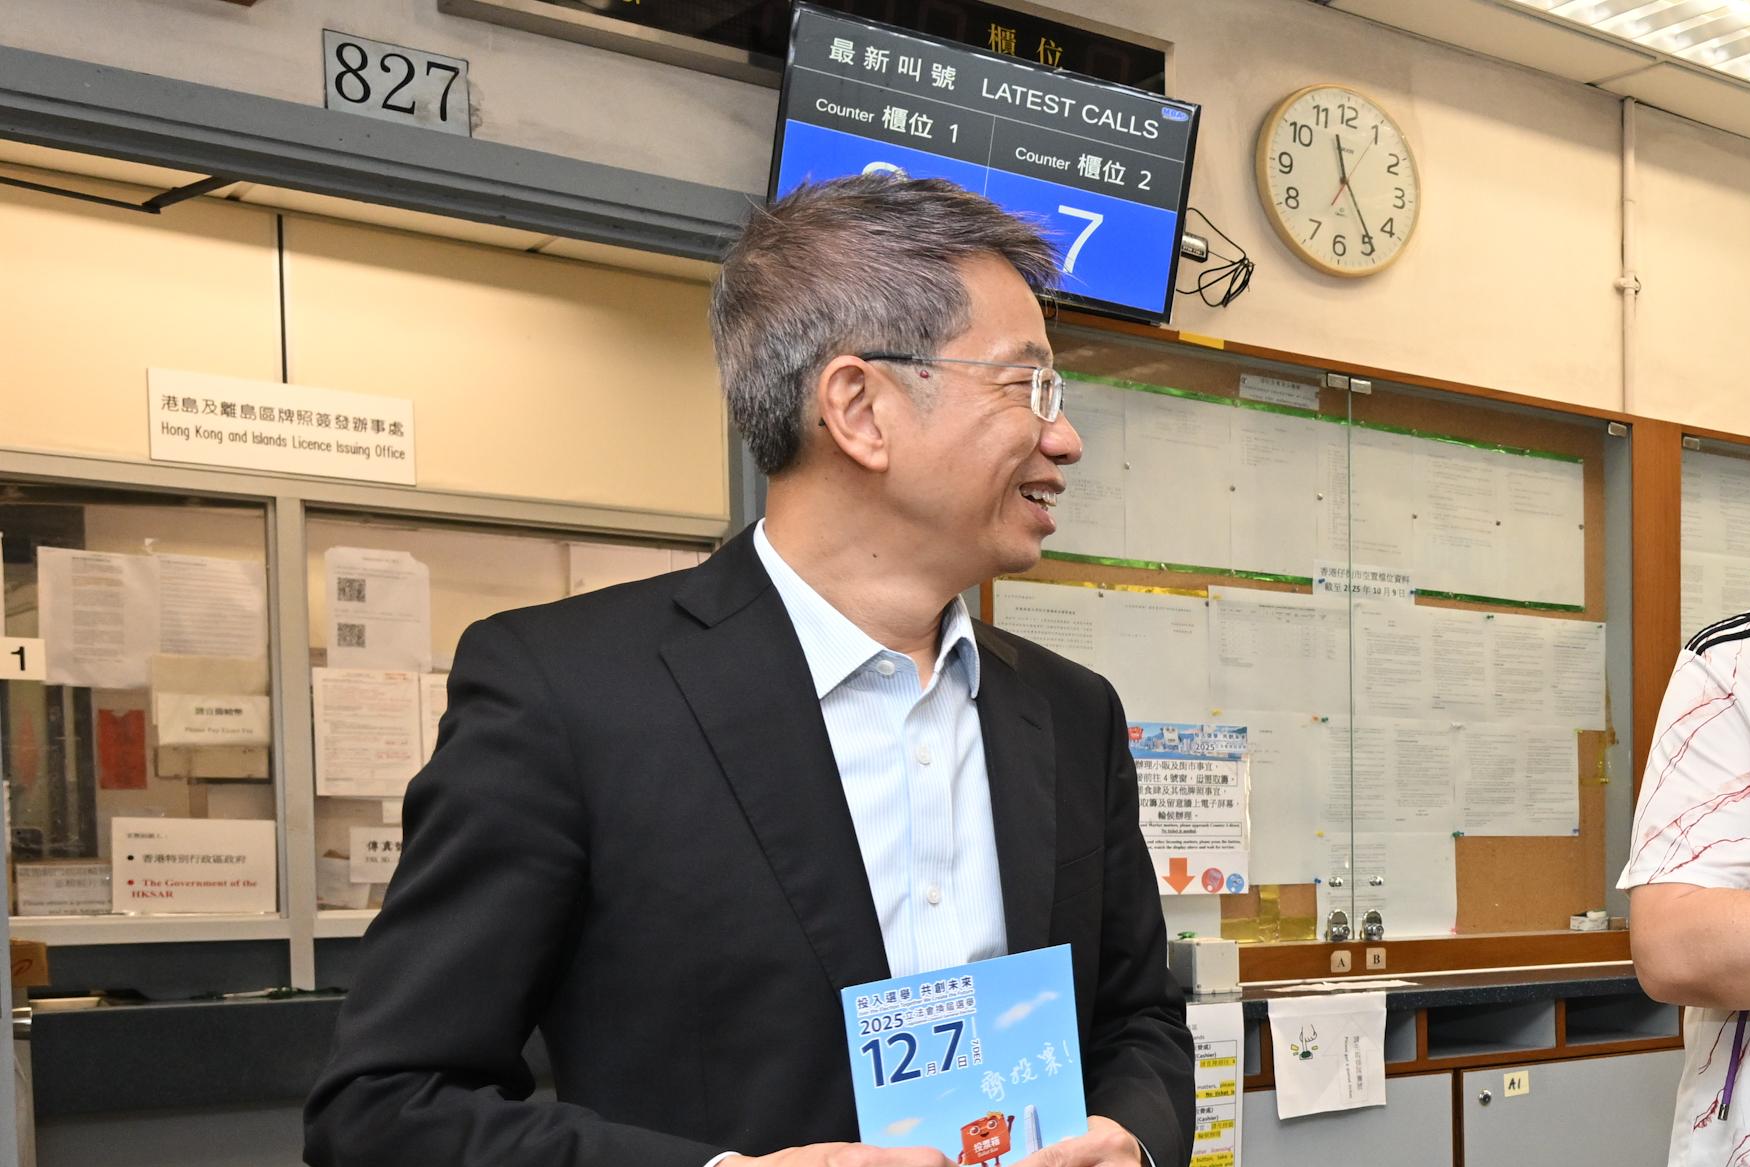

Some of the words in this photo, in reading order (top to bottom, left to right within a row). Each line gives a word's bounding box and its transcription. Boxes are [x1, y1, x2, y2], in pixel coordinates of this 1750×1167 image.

[987, 23, 1064, 68] 櫃位
[334, 42, 461, 122] 827
[829, 37, 956, 92] 最新叫號
[982, 78, 1076, 118] LATEST
[1081, 104, 1159, 140] CALLS
[815, 98, 875, 123] Counter
[882, 105, 933, 140] 櫃位
[949, 123, 959, 143] 1
[1312, 104, 1329, 129] 11
[1337, 104, 1359, 130] 12
[1290, 121, 1313, 147] 10
[1371, 124, 1379, 145] 1
[1015, 147, 1070, 171] Counter
[1077, 153, 1125, 186] 櫃位
[1138, 170, 1152, 191] 2
[1278, 152, 1293, 174] 9
[1387, 153, 1400, 175] 2
[1285, 187, 1299, 209] 8
[1393, 187, 1406, 209] 3
[1308, 218, 1322, 240] 7
[1380, 217, 1395, 238] 4
[1058, 205, 1104, 274] 7
[1332, 234, 1346, 256] 6
[1361, 233, 1375, 257] 5
[161, 394, 404, 437] 港島及離島區牌照簽發辦事處
[161, 421, 190, 441] Hong
[195, 424, 223, 444] Kong
[228, 430, 248, 443] and
[252, 432, 287, 448] Islands
[292, 435, 332, 452] Licence
[336, 440, 370, 460] Issuing
[375, 444, 405, 460] Office
[10, 646, 26, 671] 1
[143, 854, 246, 864] 香港特別行政區政府
[131, 890, 174, 898] HKSAR
[143, 879, 162, 887] The
[165, 879, 228, 888] Government
[230, 879, 239, 887] of
[243, 879, 257, 887] the
[1336, 957, 1345, 968] A
[1373, 954, 1380, 965] B
[858, 988, 911, 1009] 投入選舉
[920, 976, 972, 996] 共創未來
[860, 1013, 904, 1035] 2025
